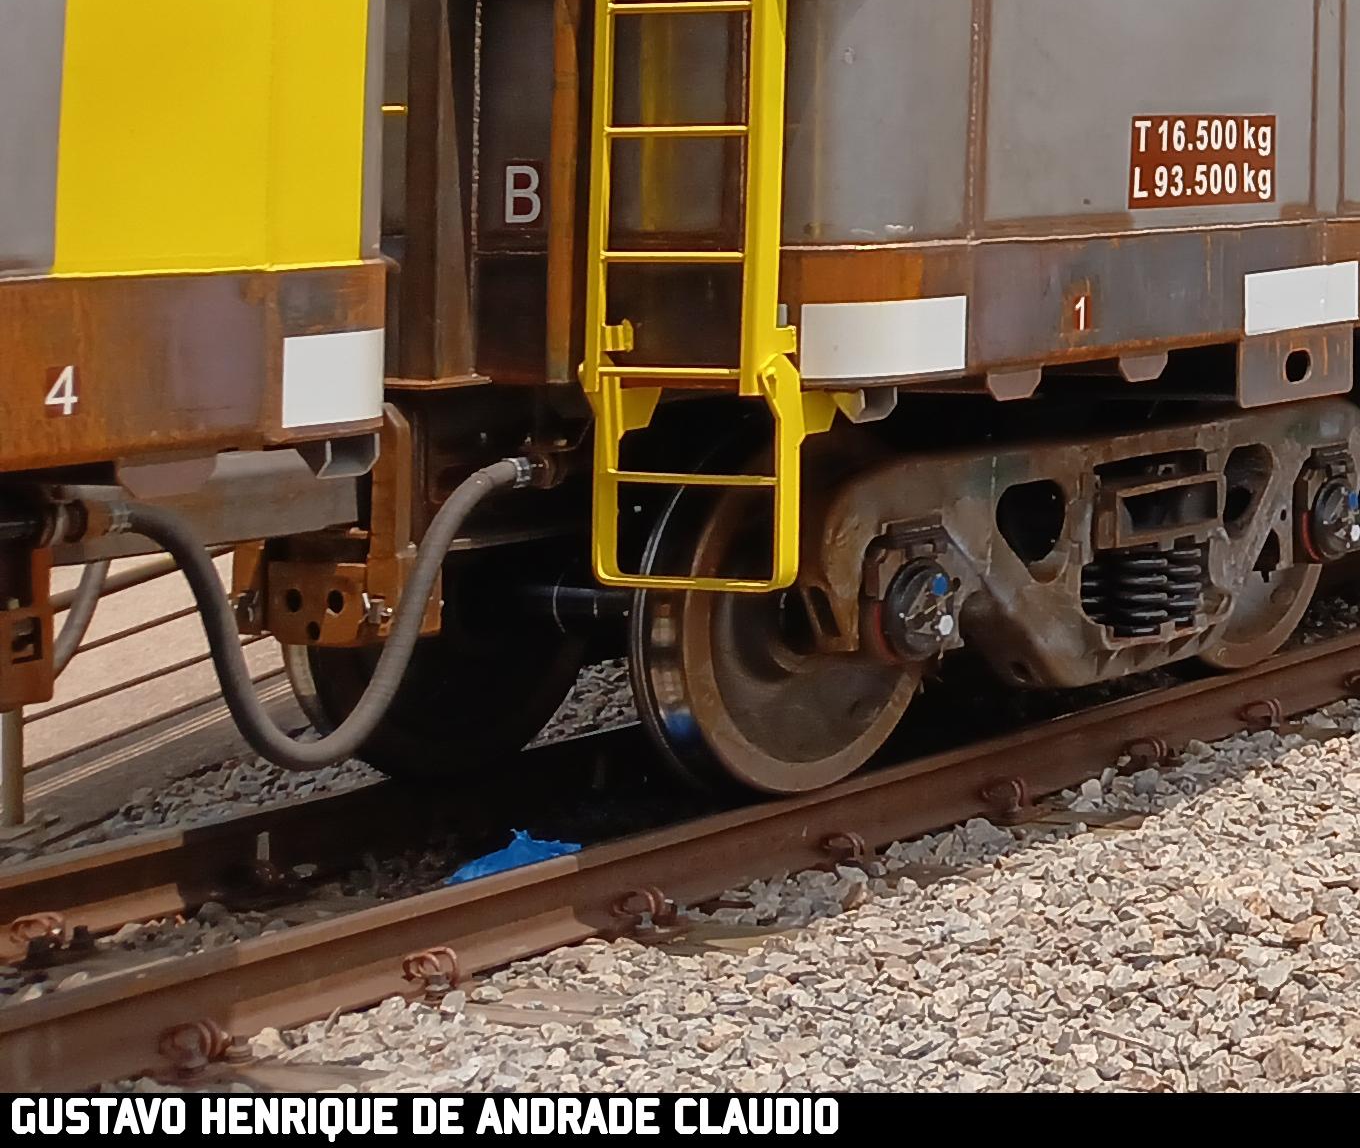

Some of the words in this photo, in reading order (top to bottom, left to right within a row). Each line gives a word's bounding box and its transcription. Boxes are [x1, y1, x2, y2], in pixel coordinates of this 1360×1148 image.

[1135, 120, 1151, 152] T
[1158, 119, 1237, 151] 16.500
[1243, 119, 1271, 156] kg
[505, 165, 541, 224] B
[1133, 166, 1148, 198] L
[1154, 163, 1237, 197] 93.500
[1243, 162, 1271, 199] kg
[1074, 296, 1085, 331] 1
[45, 365, 79, 415] 4
